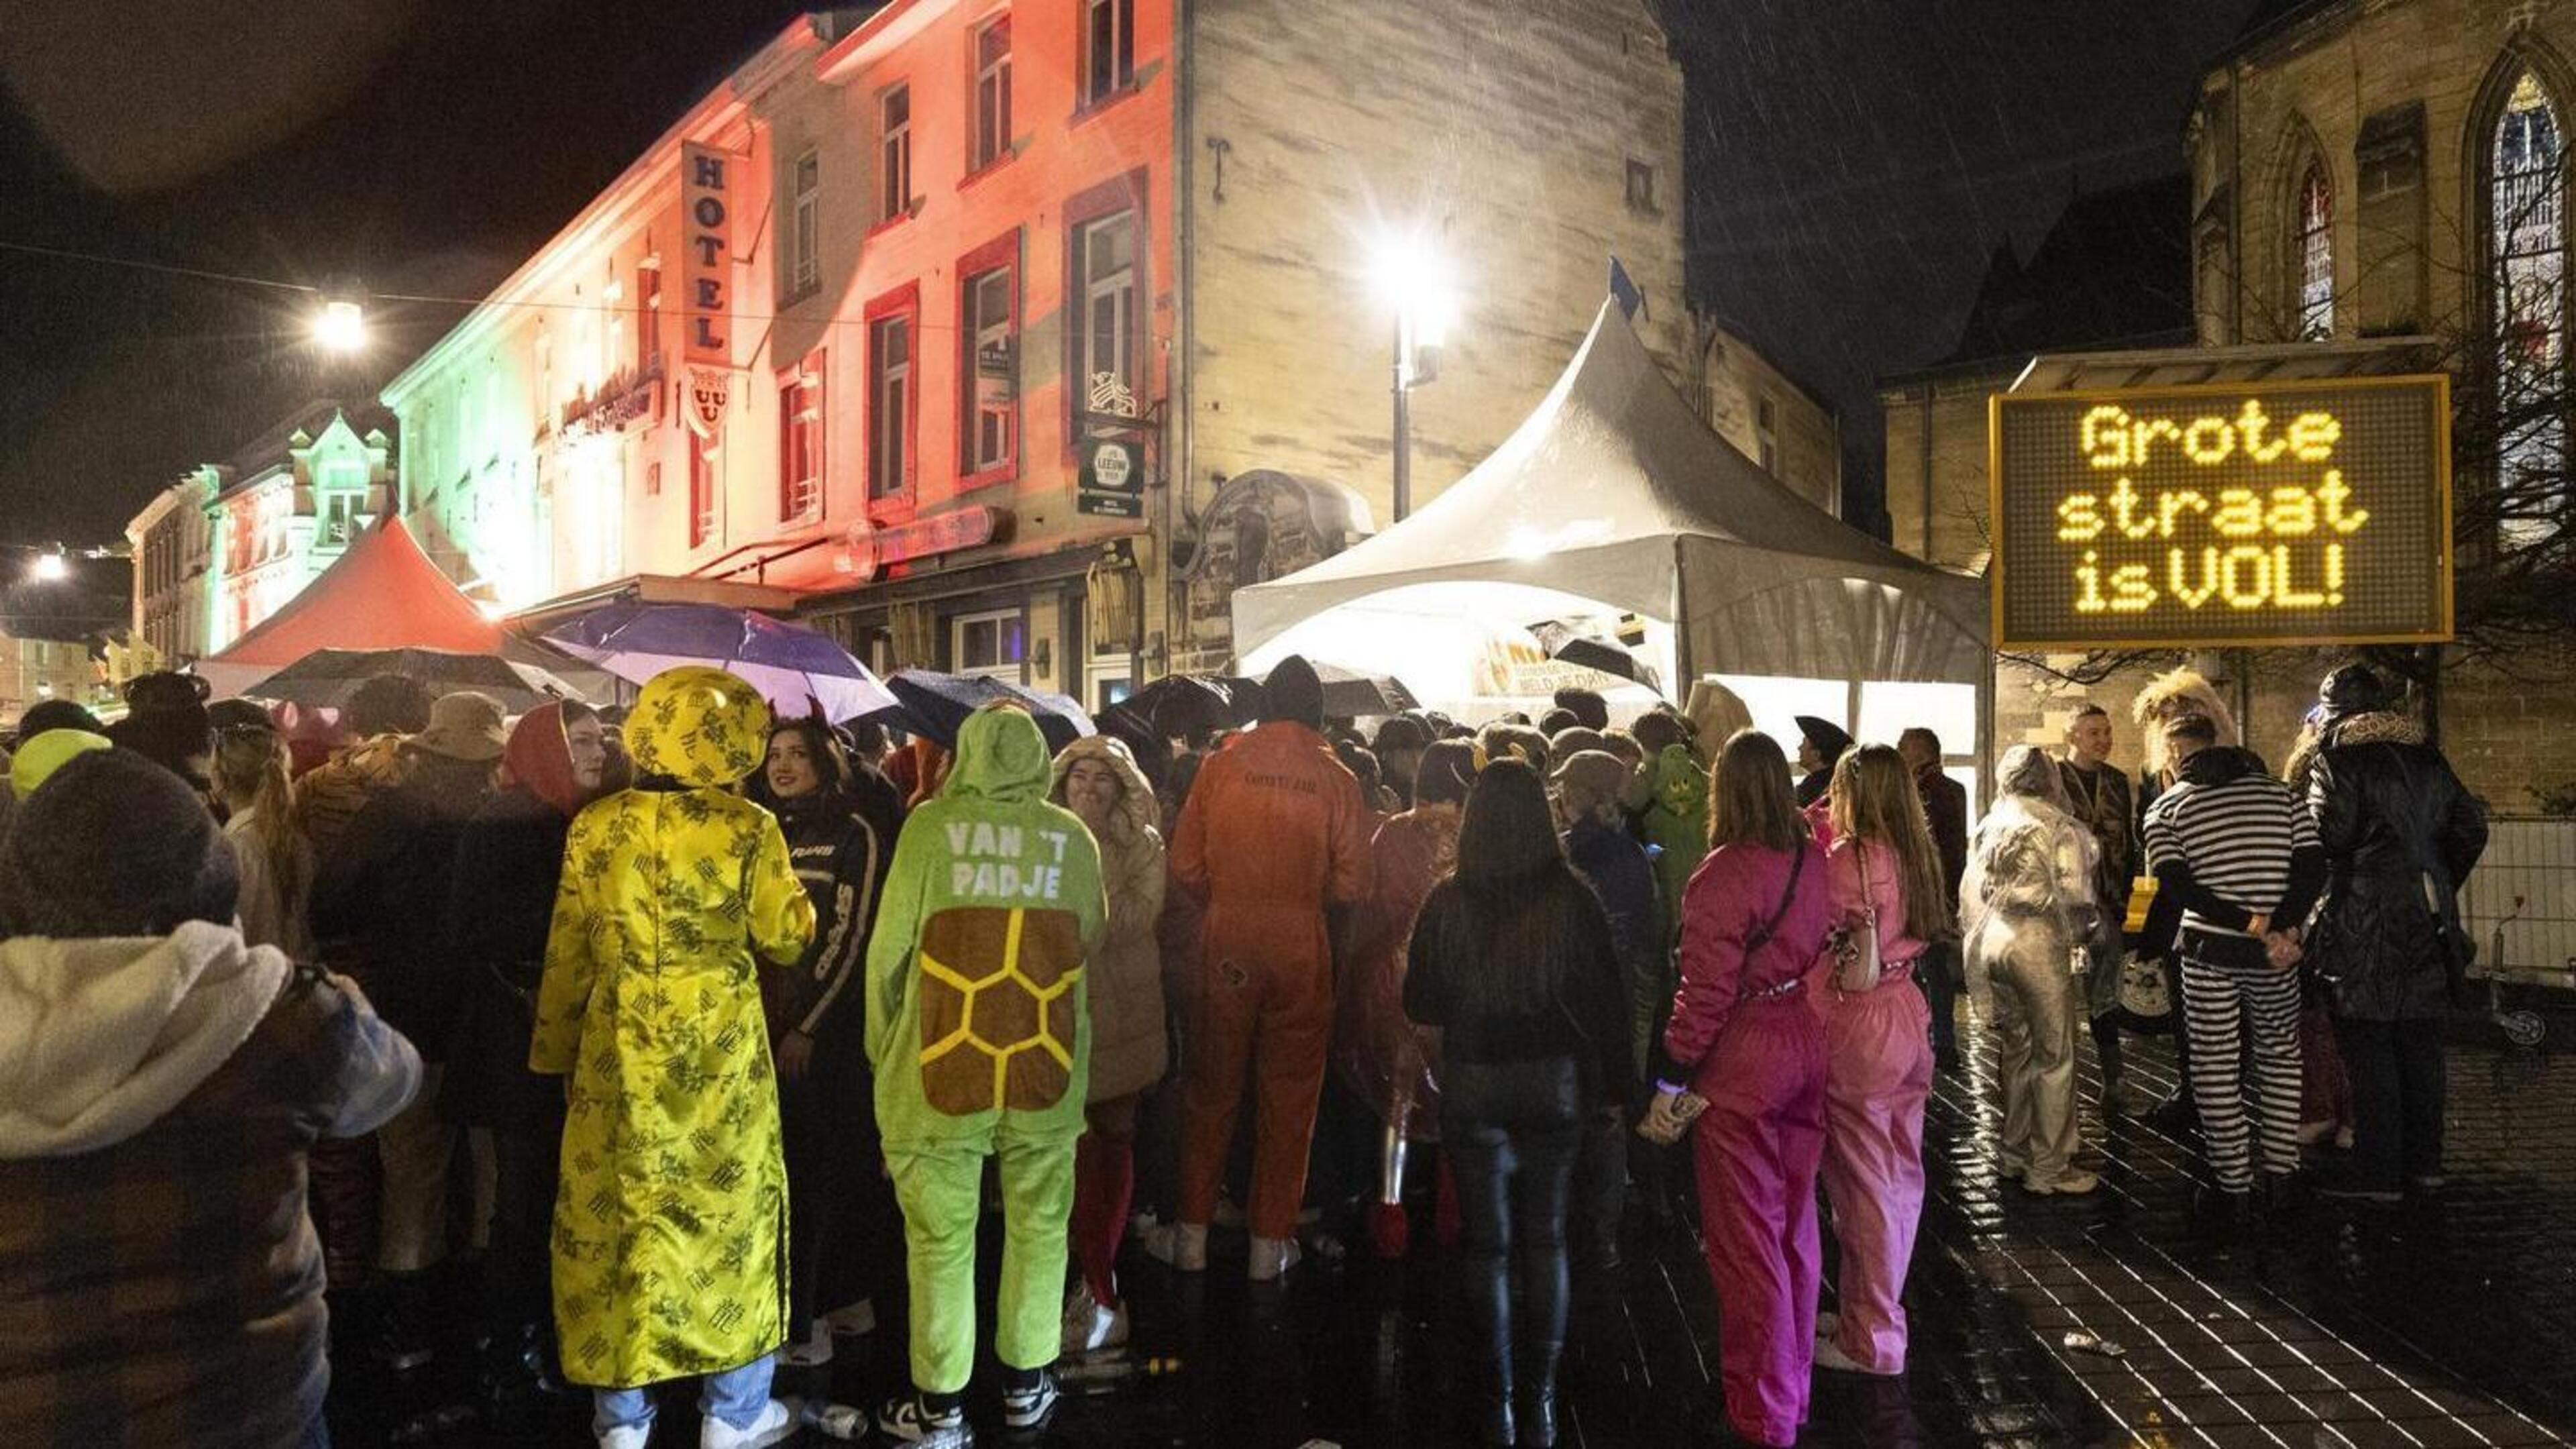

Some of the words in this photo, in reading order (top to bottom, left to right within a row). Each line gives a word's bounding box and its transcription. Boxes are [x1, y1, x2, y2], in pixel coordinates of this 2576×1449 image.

[694, 156, 724, 350] HOTEL
[2081, 398, 2341, 468] Grote
[2057, 469, 2369, 541] straat
[2076, 549, 2159, 612] is
[2168, 543, 2345, 610] VOL!
[944, 822, 1023, 858] VAN
[952, 861, 1063, 900] PADJE
